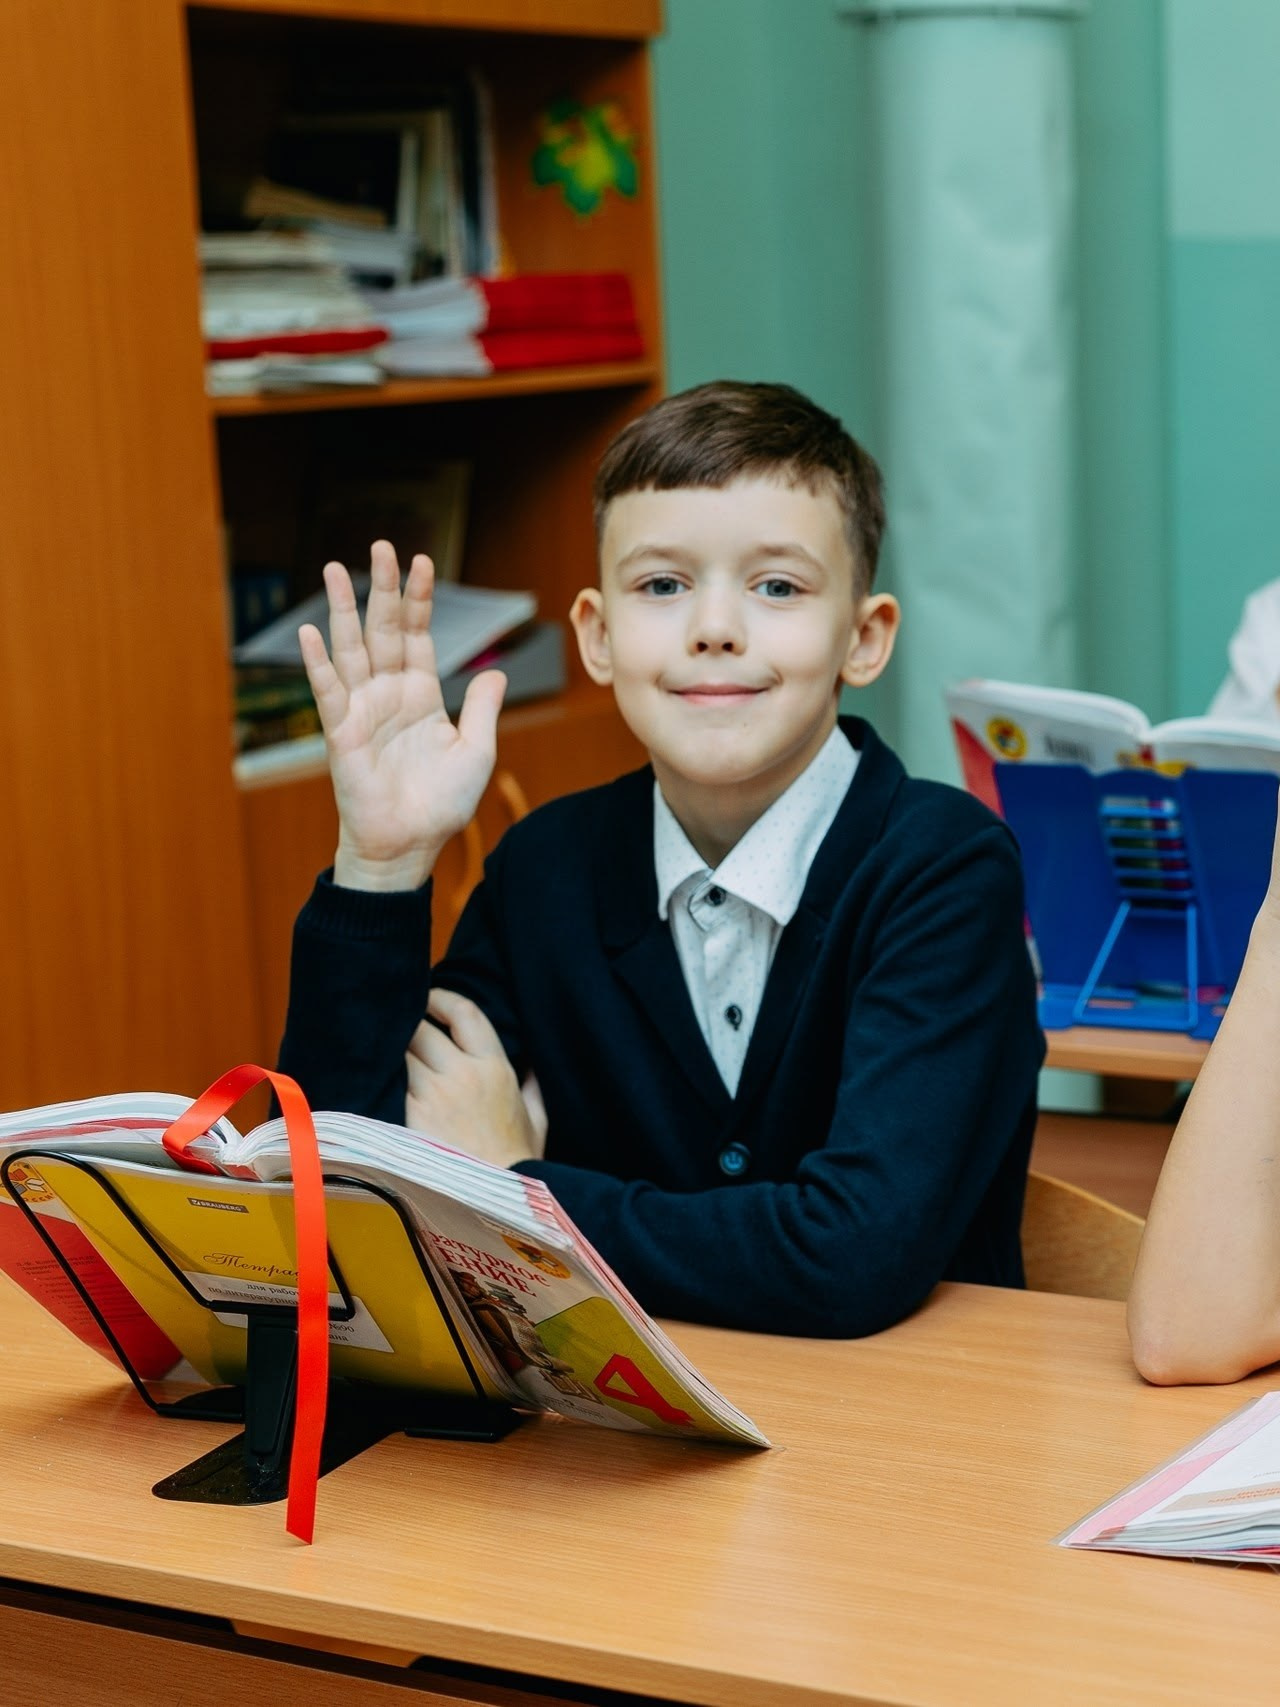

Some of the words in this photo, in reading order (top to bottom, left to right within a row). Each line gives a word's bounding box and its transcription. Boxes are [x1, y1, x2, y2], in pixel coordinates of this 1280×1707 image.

[200, 1201, 242, 1211] BRAUBERG
[427, 1230, 550, 1287] ратурное
[436, 1245, 538, 1298] ЕНИЕ
[593, 1353, 697, 1428] 4
